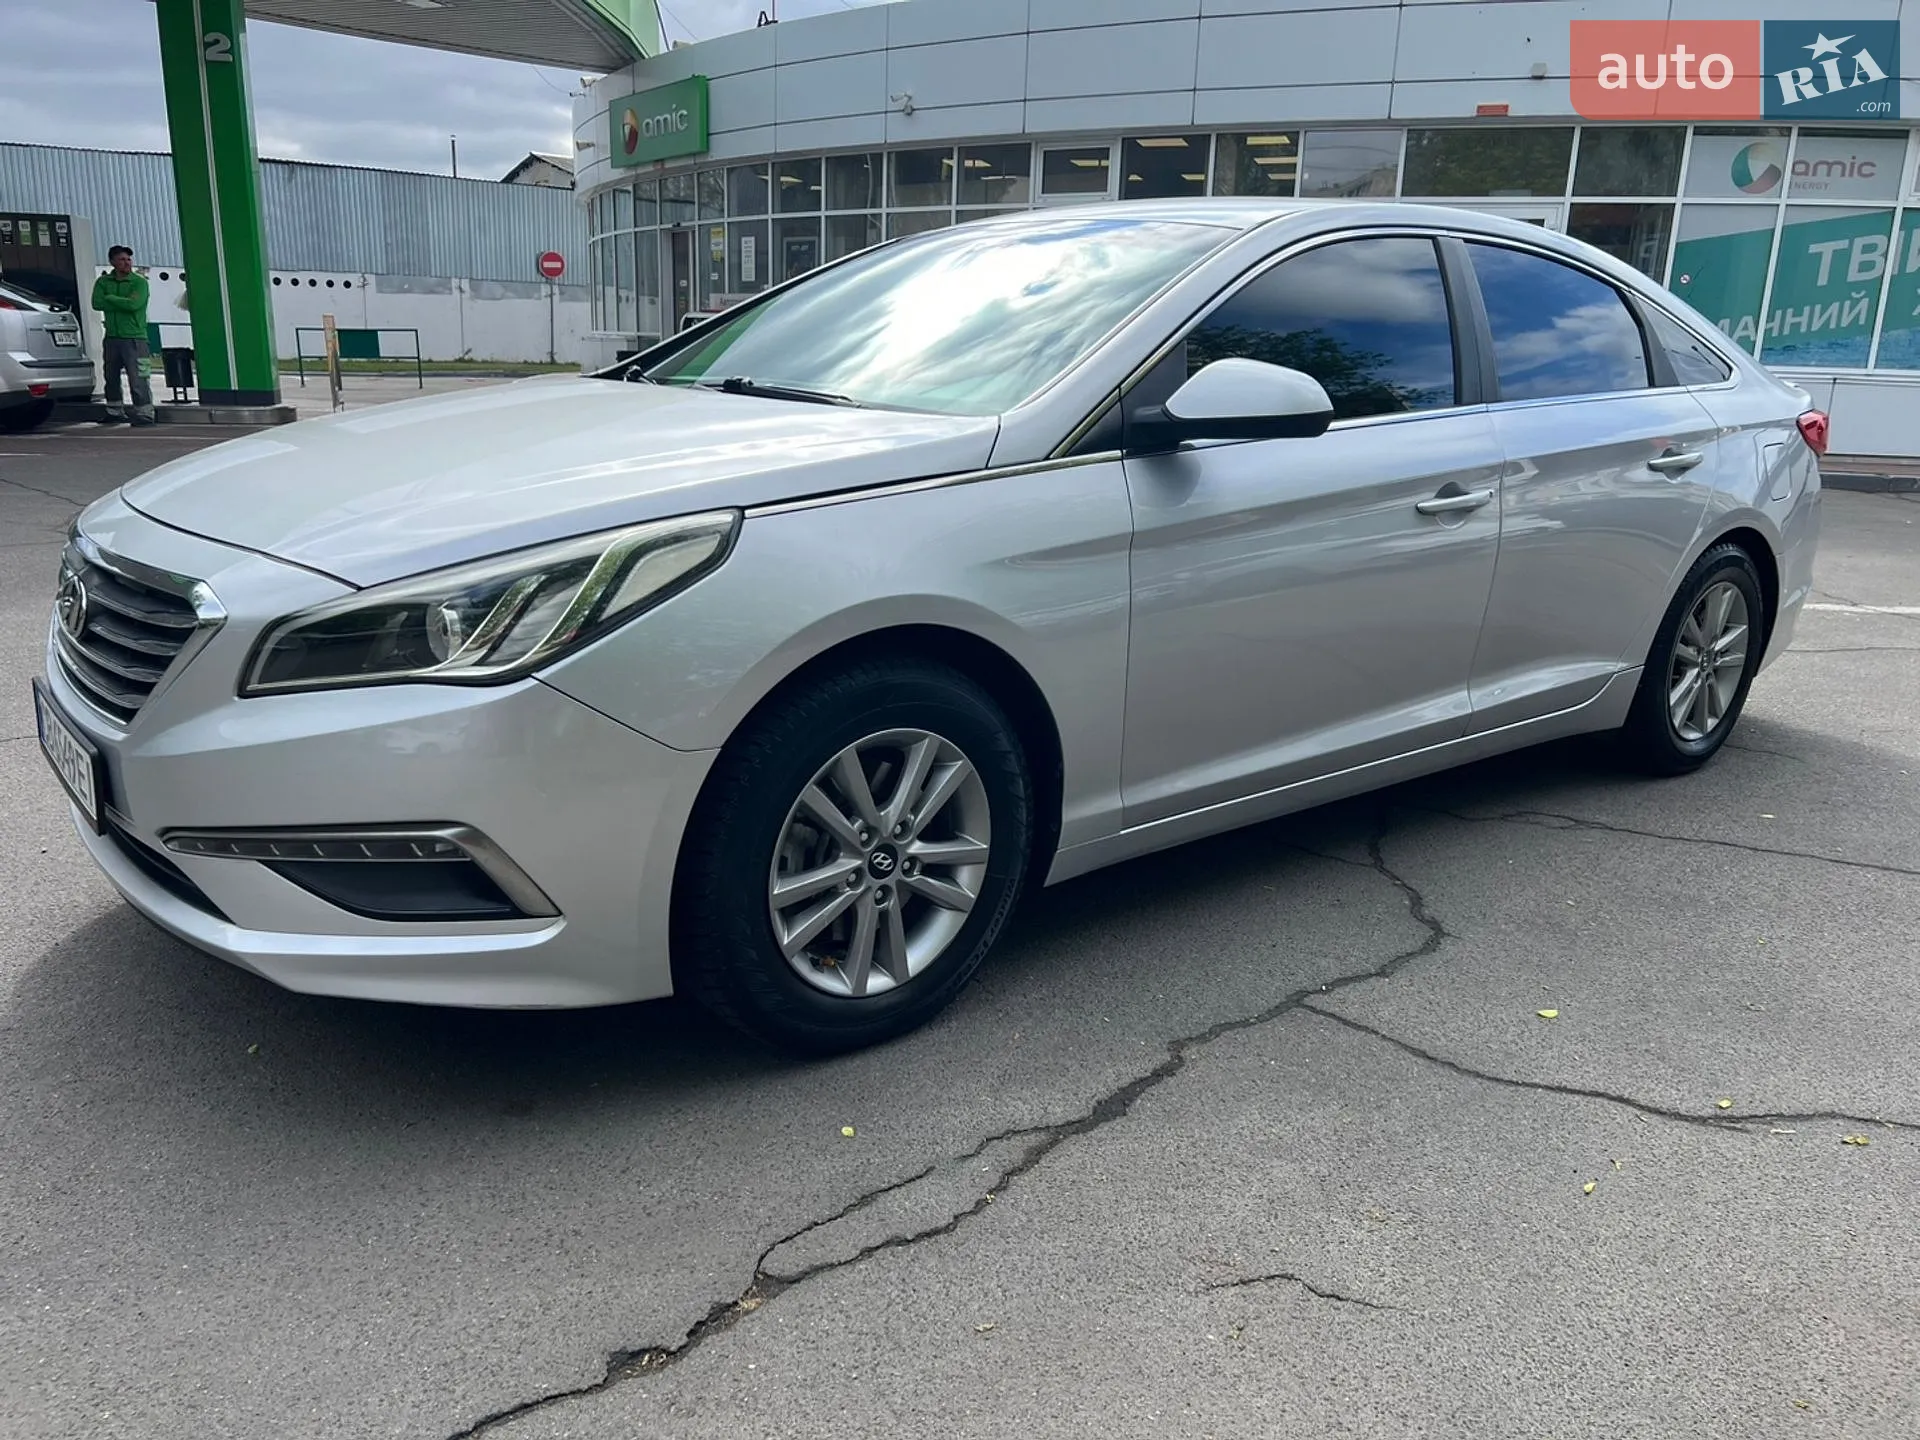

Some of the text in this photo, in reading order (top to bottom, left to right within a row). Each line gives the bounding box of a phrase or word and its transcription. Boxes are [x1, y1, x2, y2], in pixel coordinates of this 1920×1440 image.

[204, 32, 233, 62] 2
[642, 103, 688, 137] amic
[1790, 156, 1876, 179] amic
[1789, 181, 1830, 191] NERGY
